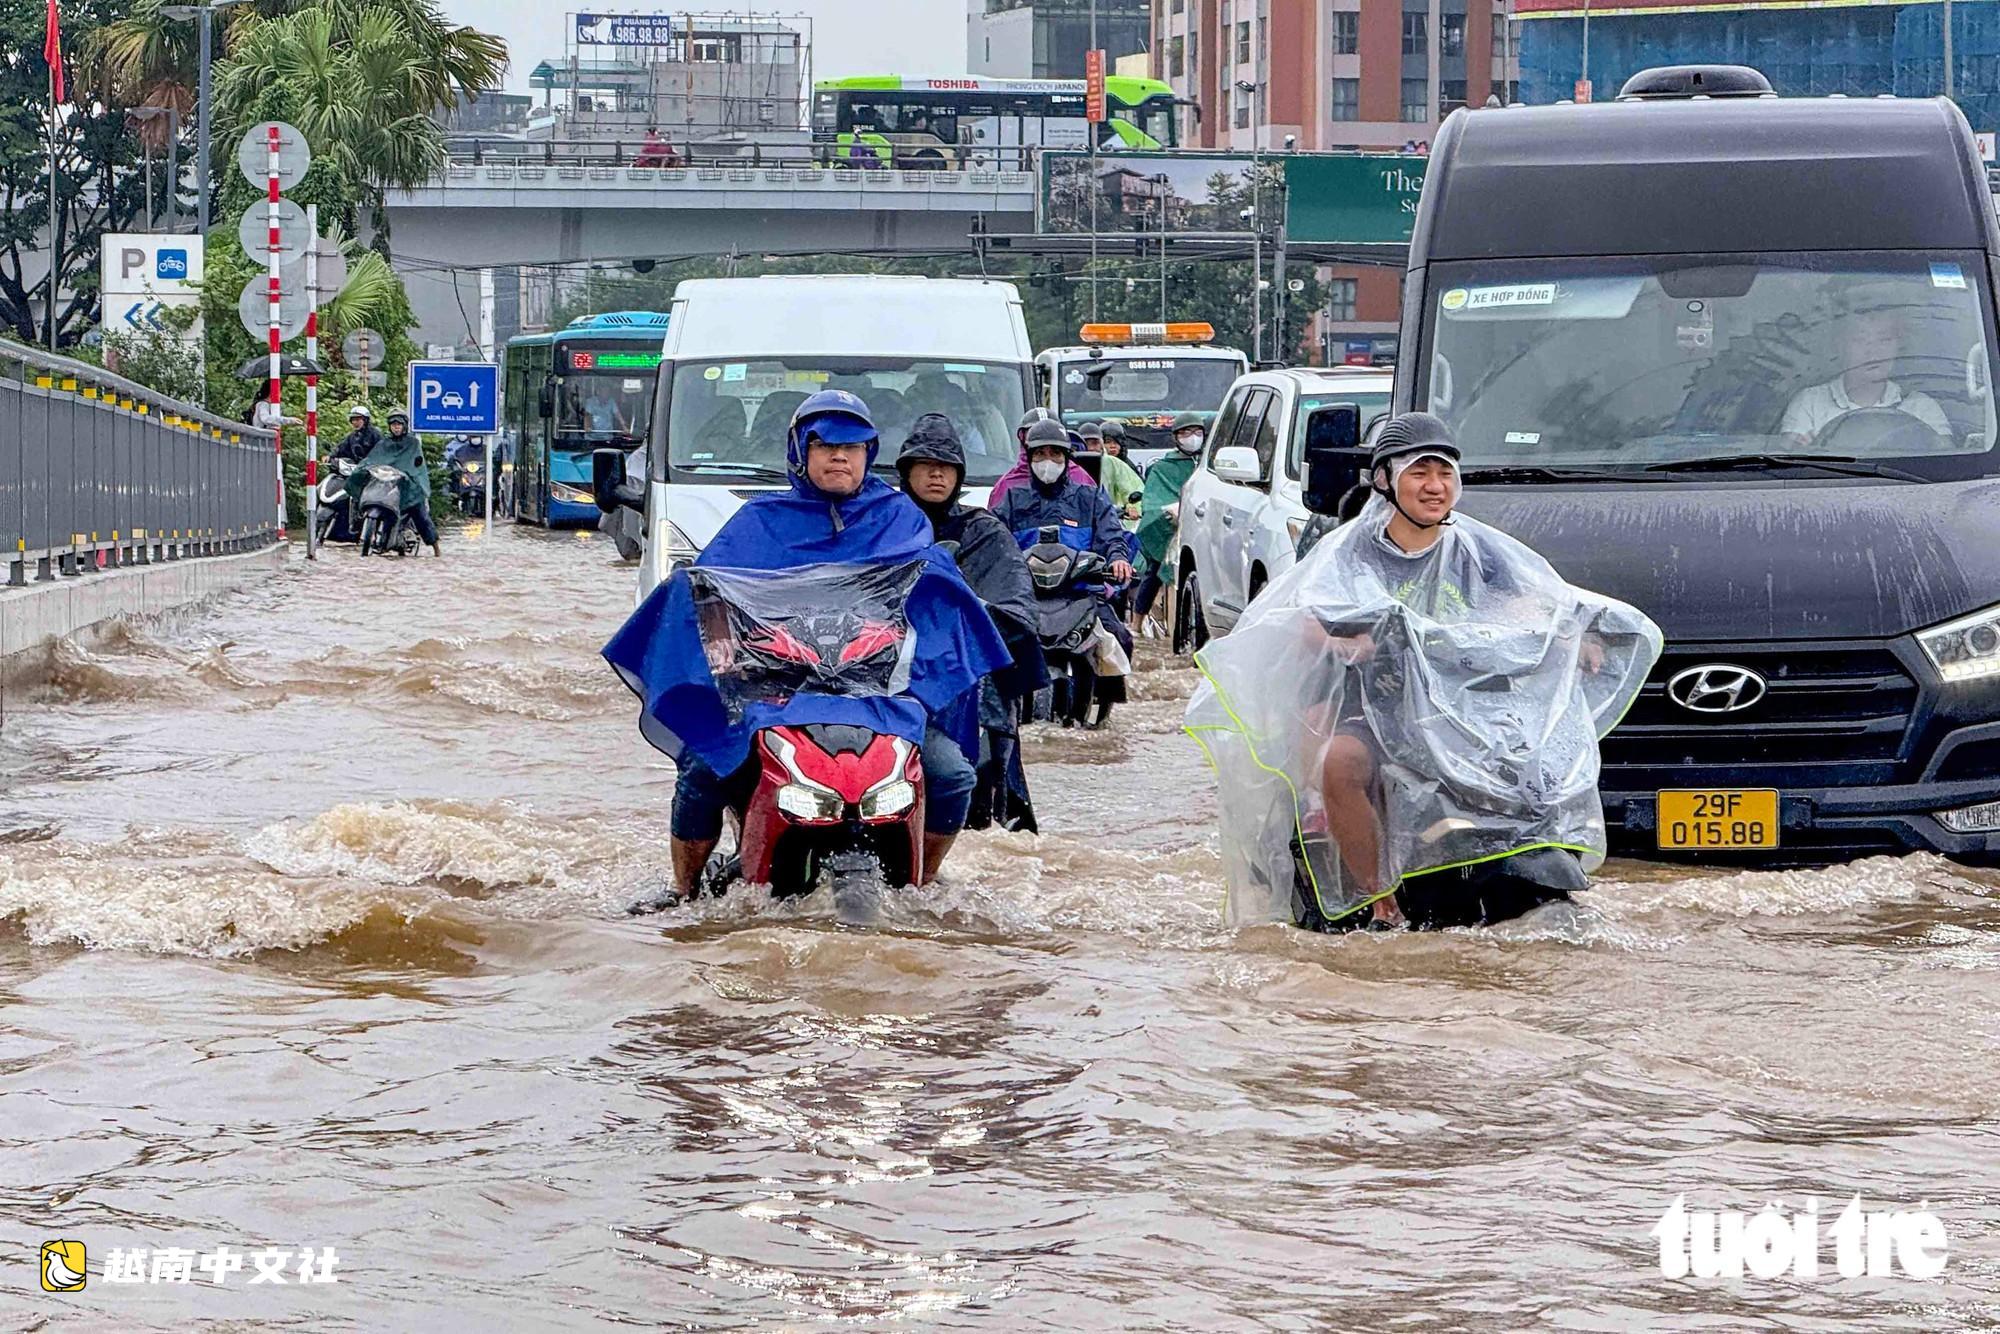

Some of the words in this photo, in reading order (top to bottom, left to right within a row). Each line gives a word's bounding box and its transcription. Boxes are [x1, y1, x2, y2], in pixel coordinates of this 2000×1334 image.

[927, 79, 979, 89] TOSHIBA
[1380, 169, 1424, 192] The
[121, 248, 146, 279] P
[1473, 293, 1489, 304] XE
[420, 380, 442, 409] P
[1693, 794, 1742, 817] 29F
[1672, 821, 1764, 845] 015.88
